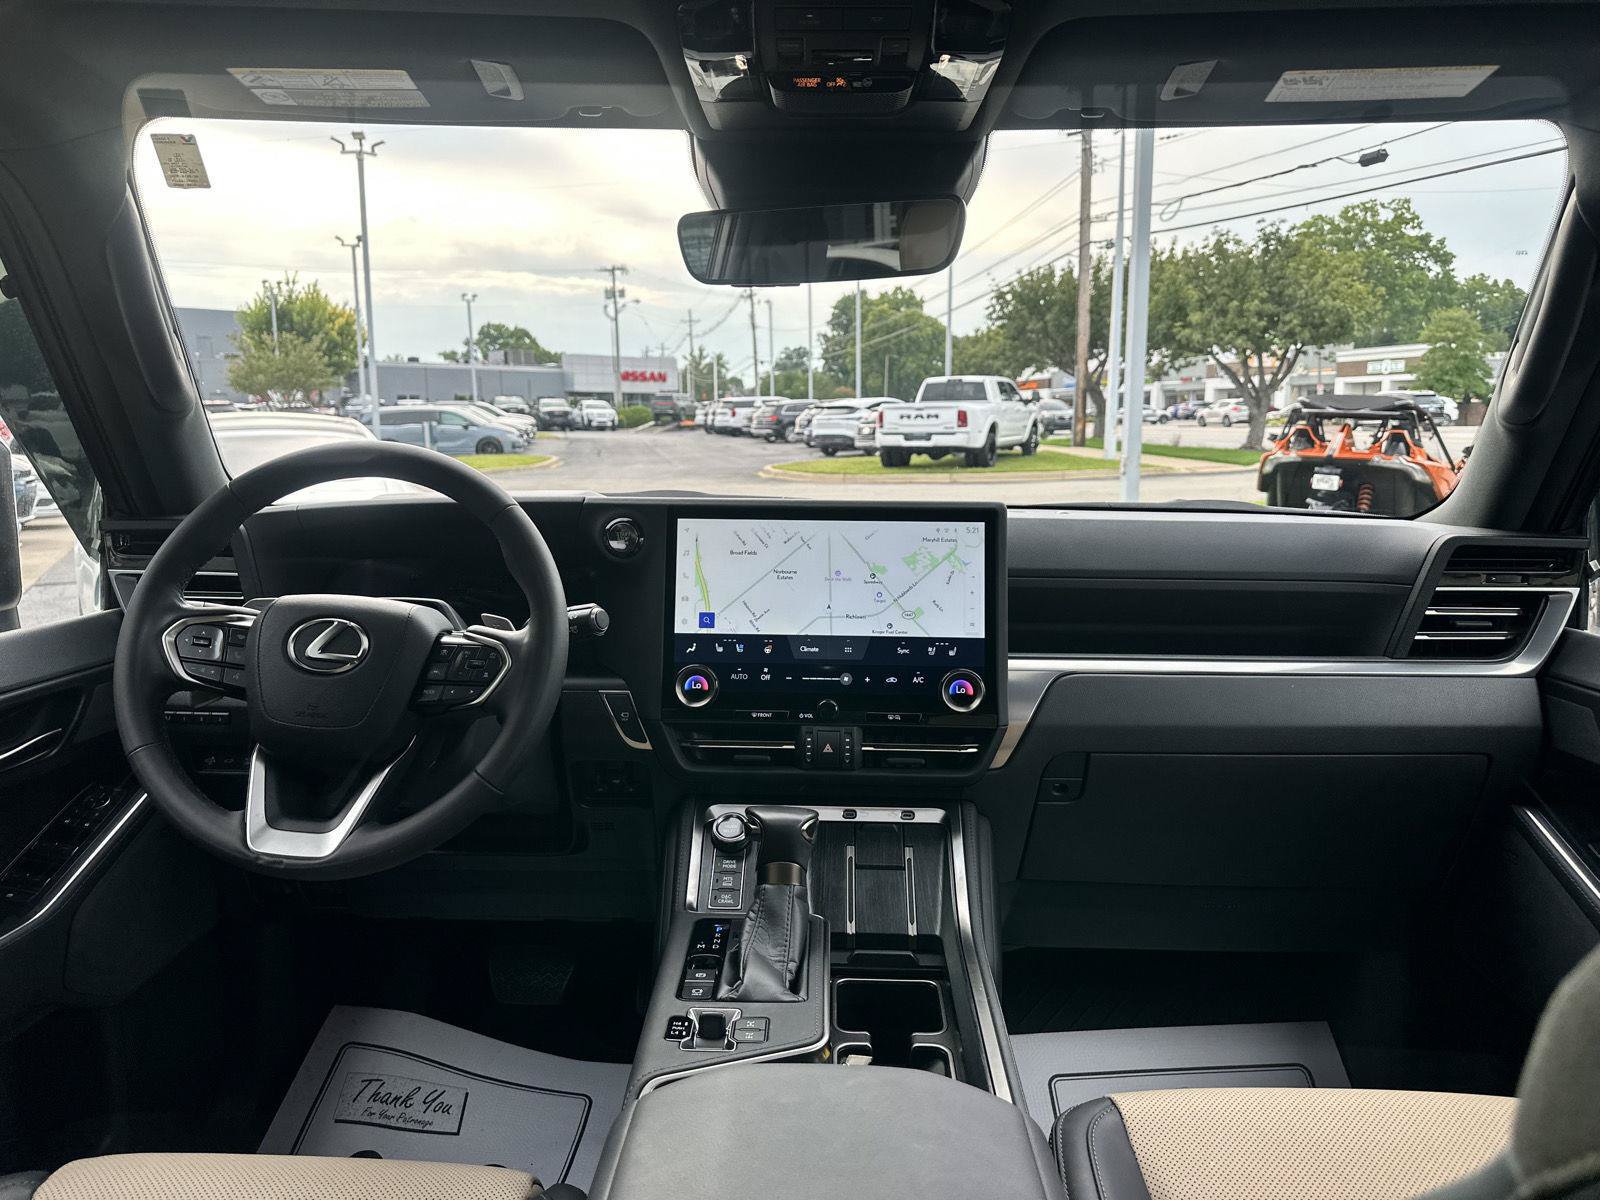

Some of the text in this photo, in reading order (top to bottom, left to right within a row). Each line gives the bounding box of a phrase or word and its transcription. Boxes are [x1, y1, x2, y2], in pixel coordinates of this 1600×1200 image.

[692, 681, 702, 689] Lo
[352, 1078, 452, 1114] Thank You
[362, 1106, 434, 1129] For Your Patronage
